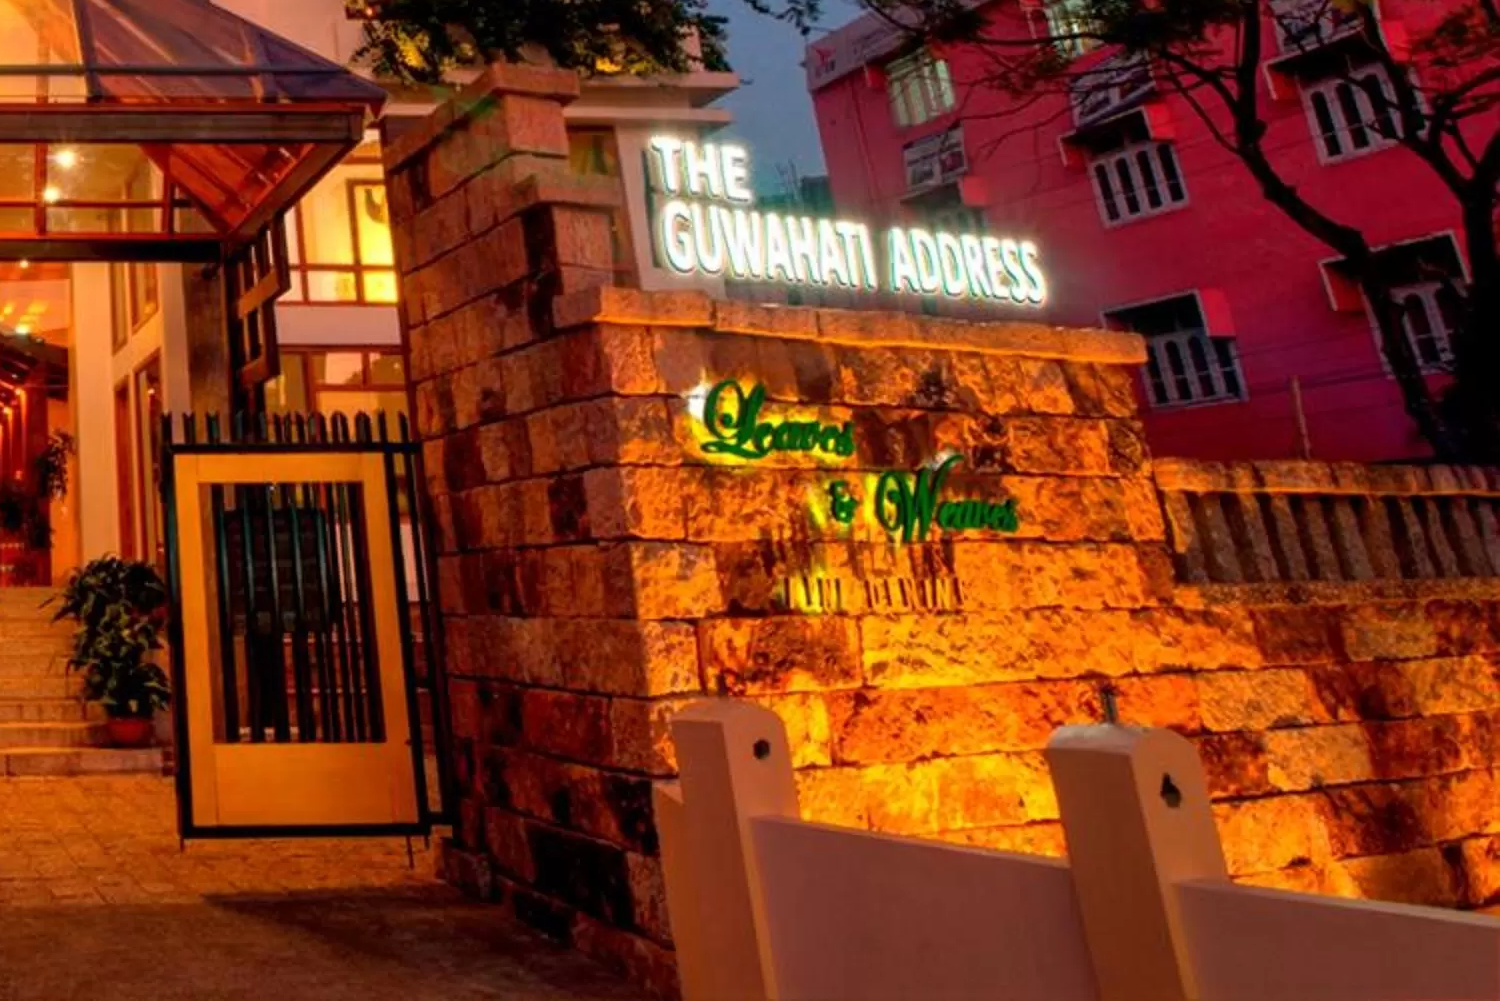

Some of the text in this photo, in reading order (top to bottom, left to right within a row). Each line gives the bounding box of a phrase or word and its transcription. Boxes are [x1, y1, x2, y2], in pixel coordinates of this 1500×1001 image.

[651, 136, 752, 204] THE
[661, 201, 1047, 304] GUWAHATI ADDRESS
[700, 379, 855, 460] Leaves
[828, 454, 1019, 543] & Weaves
